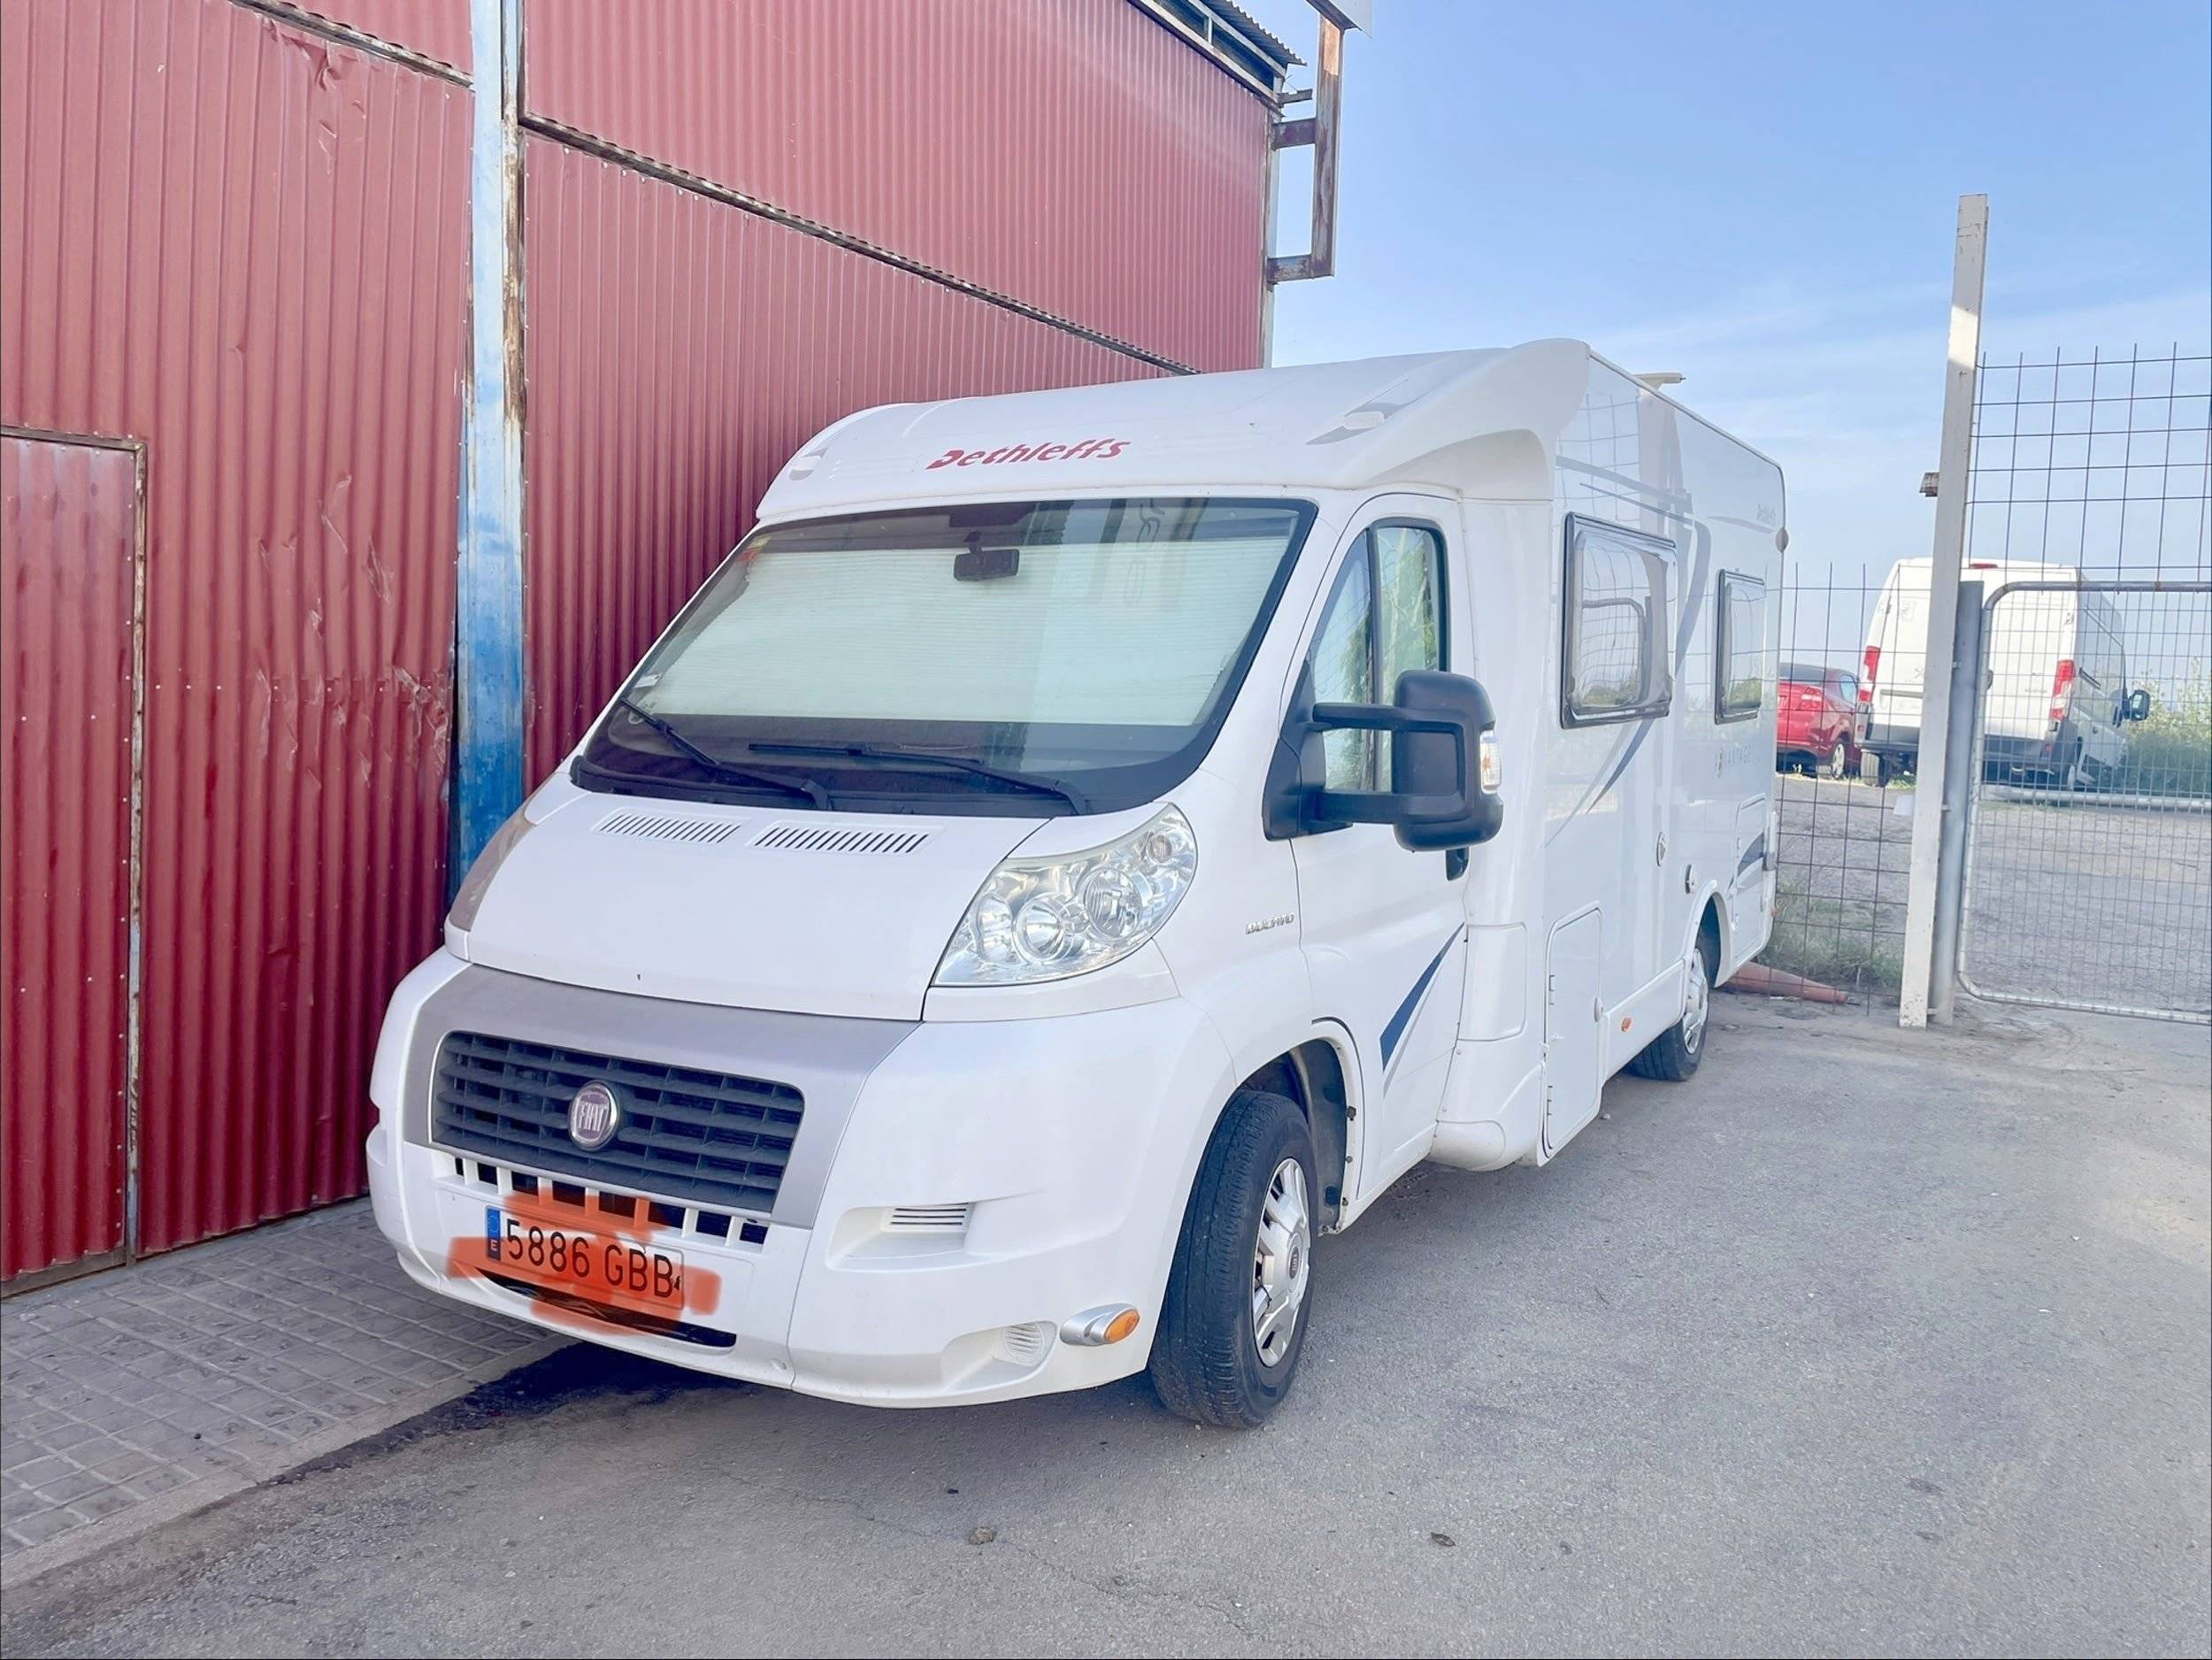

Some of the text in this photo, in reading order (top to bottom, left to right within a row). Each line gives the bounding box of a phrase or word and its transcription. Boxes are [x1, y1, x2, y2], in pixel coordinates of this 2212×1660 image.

[925, 437, 1132, 471] Dethleffs
[578, 1100, 610, 1133] FIAT
[506, 1218, 674, 1299] 5886 GBB
